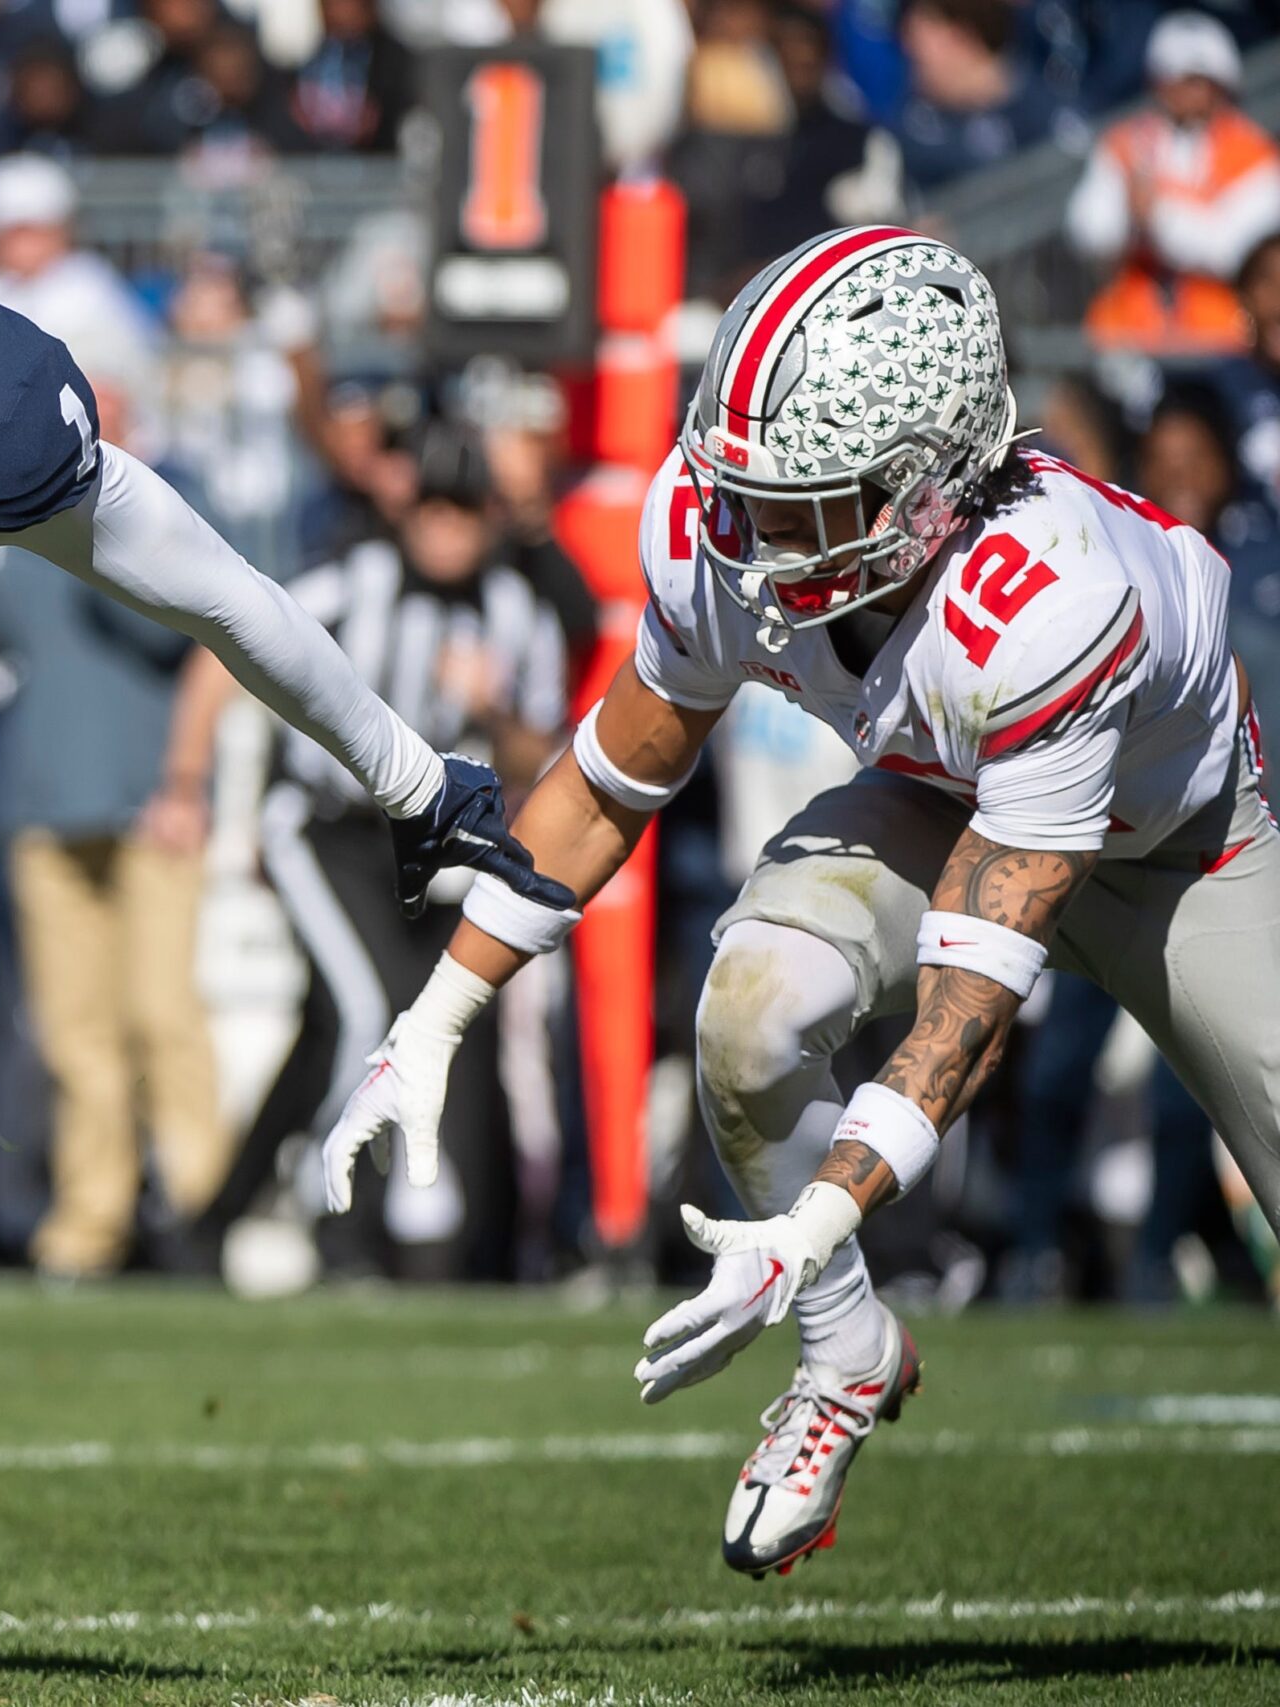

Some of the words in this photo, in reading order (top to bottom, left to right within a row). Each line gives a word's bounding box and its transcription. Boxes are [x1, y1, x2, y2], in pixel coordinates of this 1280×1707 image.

[462, 60, 545, 249] 1
[59, 383, 97, 482] 1
[944, 532, 1060, 671] 12
